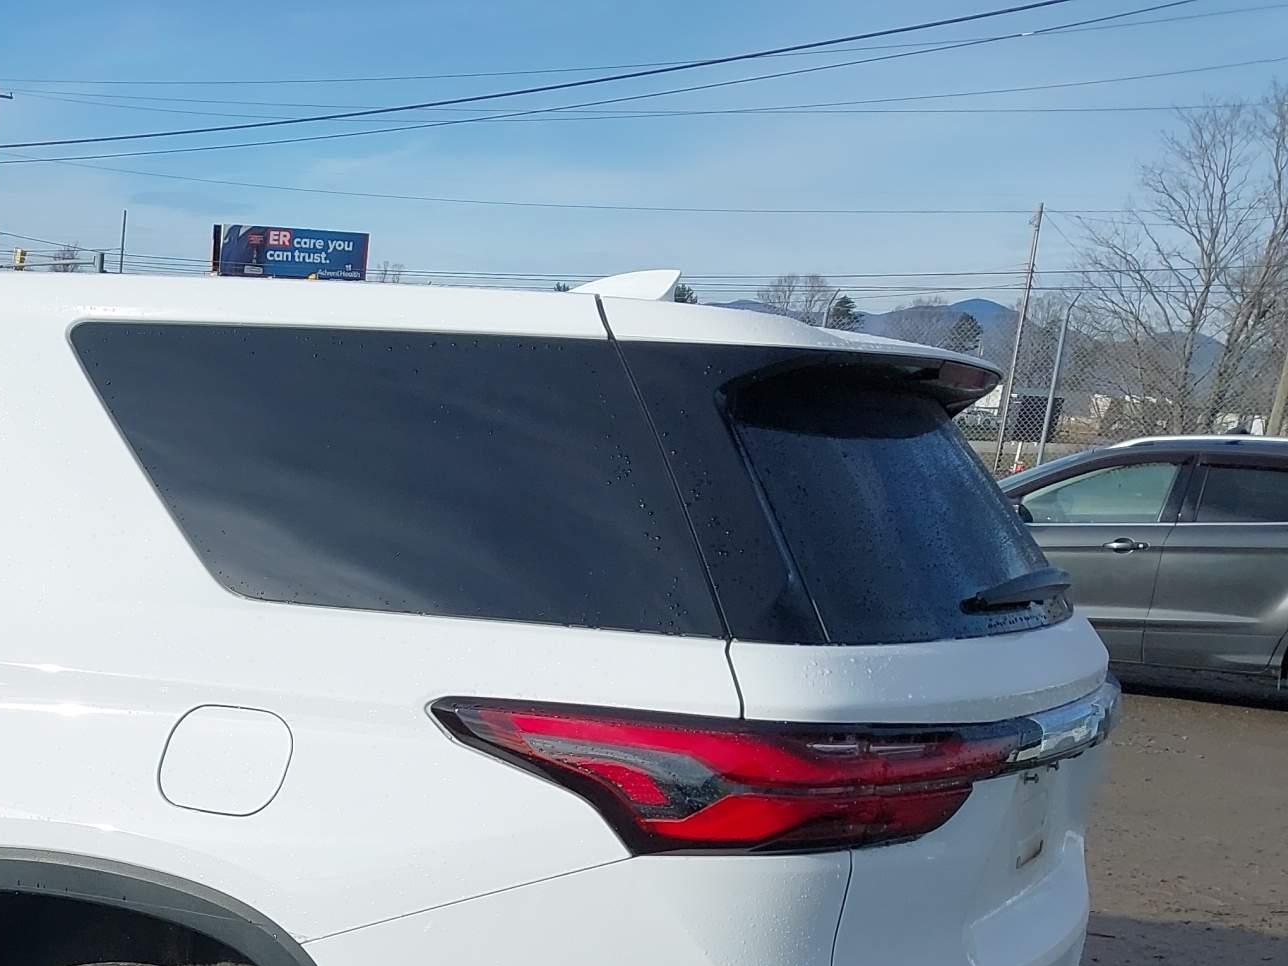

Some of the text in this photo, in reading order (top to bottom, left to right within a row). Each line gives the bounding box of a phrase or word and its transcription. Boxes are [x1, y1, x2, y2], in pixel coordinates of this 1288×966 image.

[269, 231, 291, 246] ER
[293, 237, 324, 249] care
[328, 240, 353, 252] you
[266, 249, 330, 264] can trust.
